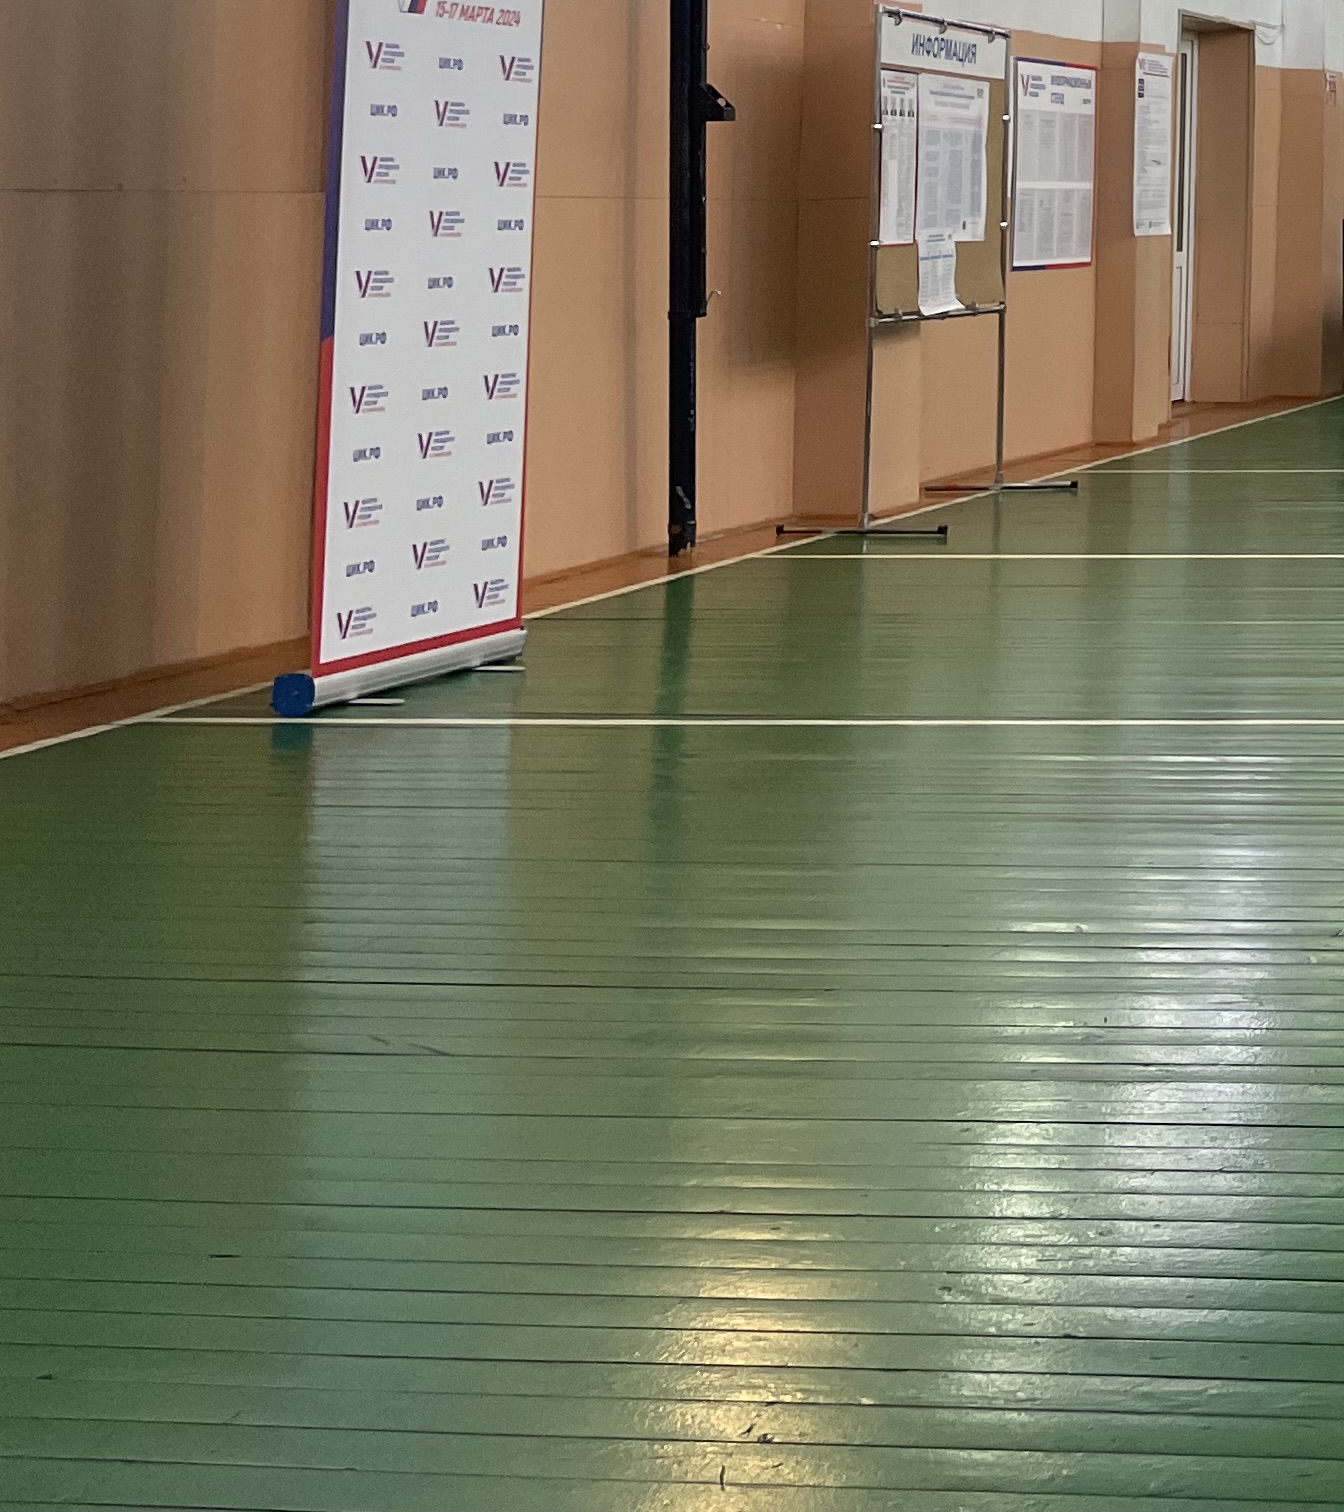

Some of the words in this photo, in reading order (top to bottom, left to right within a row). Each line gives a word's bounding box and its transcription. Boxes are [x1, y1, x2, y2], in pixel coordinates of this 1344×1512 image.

[459, 3, 495, 24] МАРТА
[495, 8, 521, 27] 2024
[911, 33, 977, 67] ИНФОРМАЦИЯ
